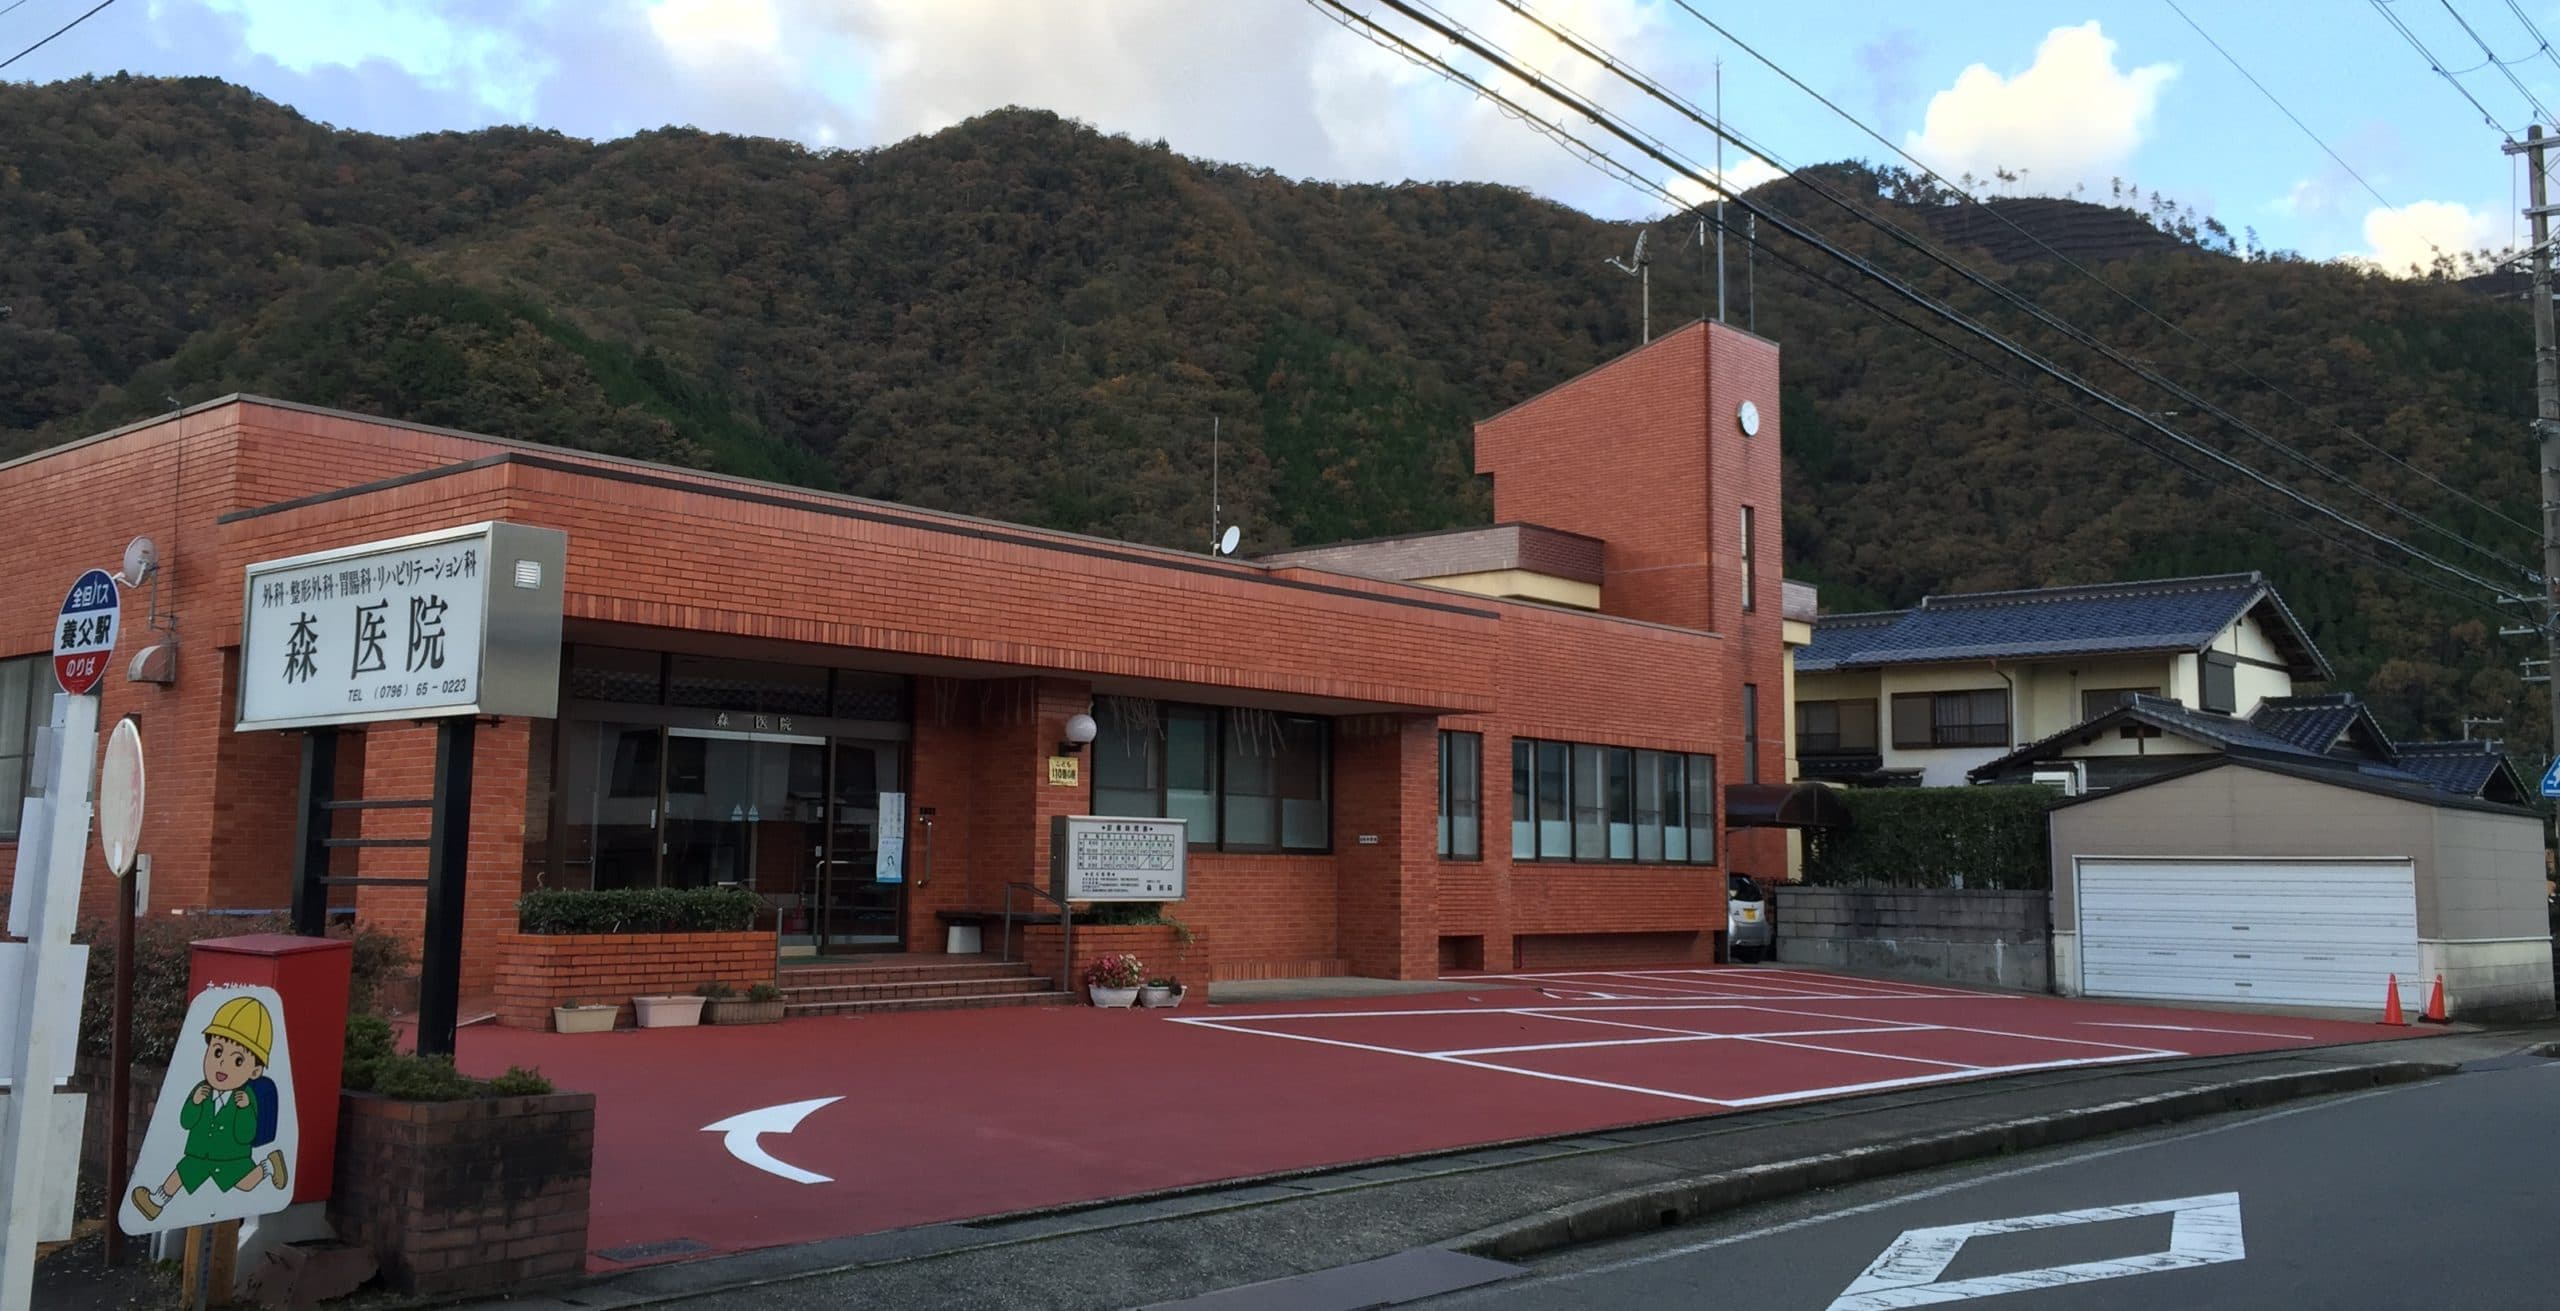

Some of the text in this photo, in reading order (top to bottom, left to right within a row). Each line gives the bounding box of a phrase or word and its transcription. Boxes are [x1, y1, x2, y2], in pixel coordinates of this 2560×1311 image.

[60, 614, 112, 650] 養父駅
[65, 656, 96, 677] のりば
[347, 688, 363, 702] TEL
[374, 684, 409, 699] (0796)
